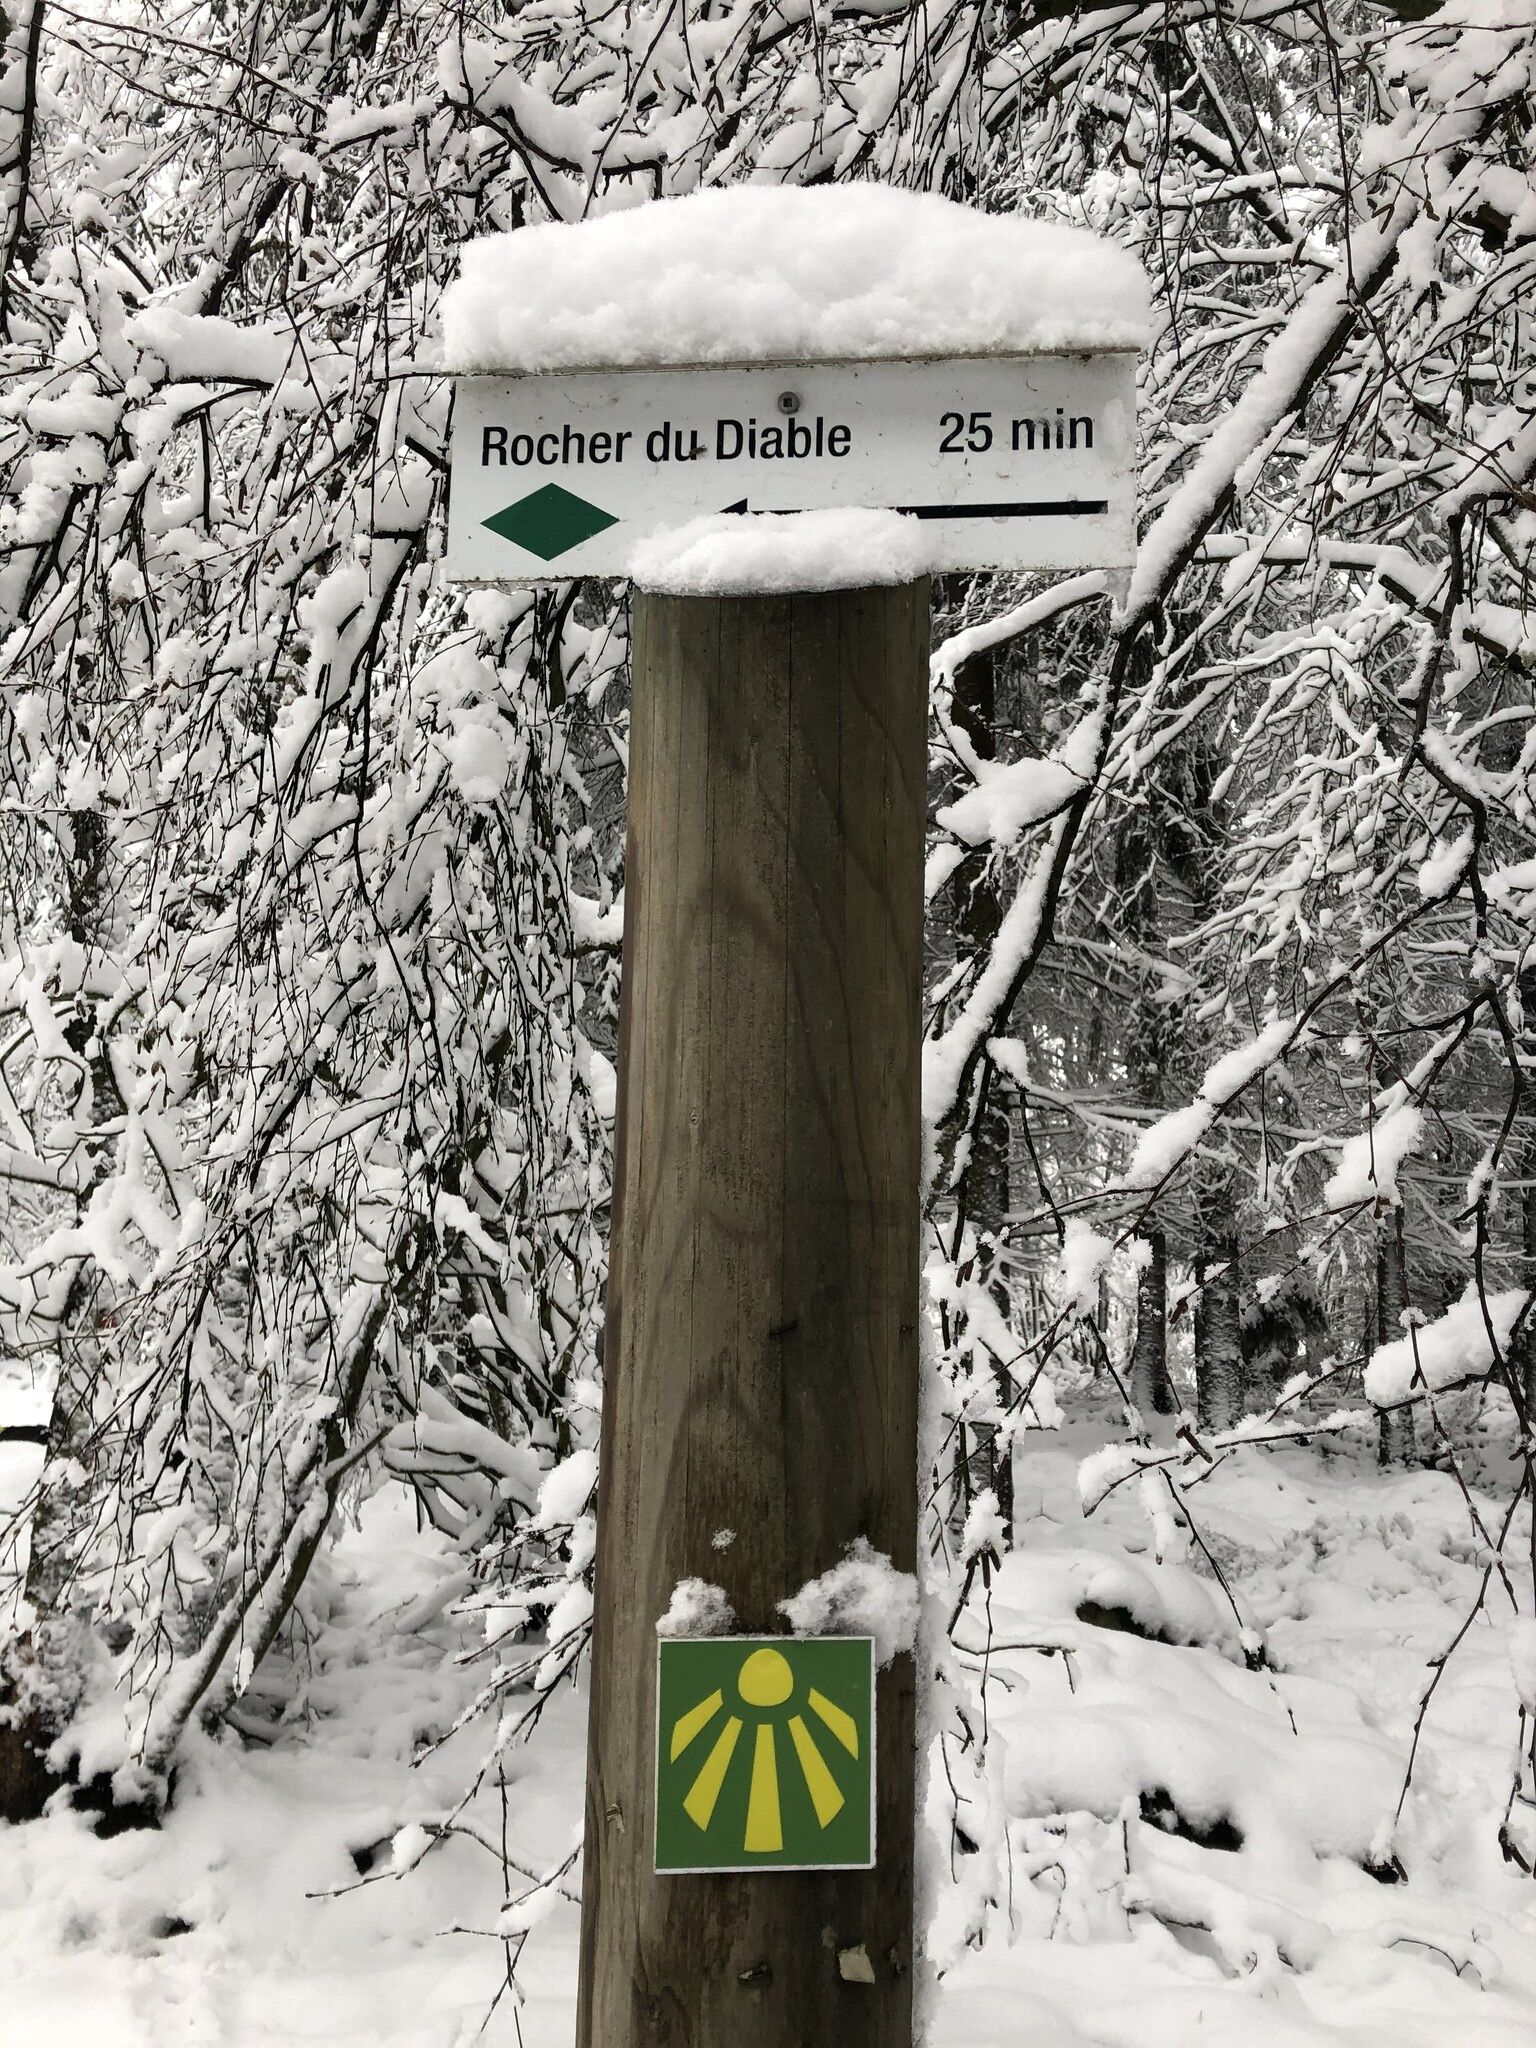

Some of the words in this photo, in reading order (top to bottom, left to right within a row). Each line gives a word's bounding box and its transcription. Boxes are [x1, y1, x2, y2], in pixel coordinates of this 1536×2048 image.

[482, 423, 633, 467] Rocher
[646, 418, 702, 465] du
[716, 416, 852, 462] Diable
[938, 411, 994, 455] 25
[1011, 407, 1094, 452] min
